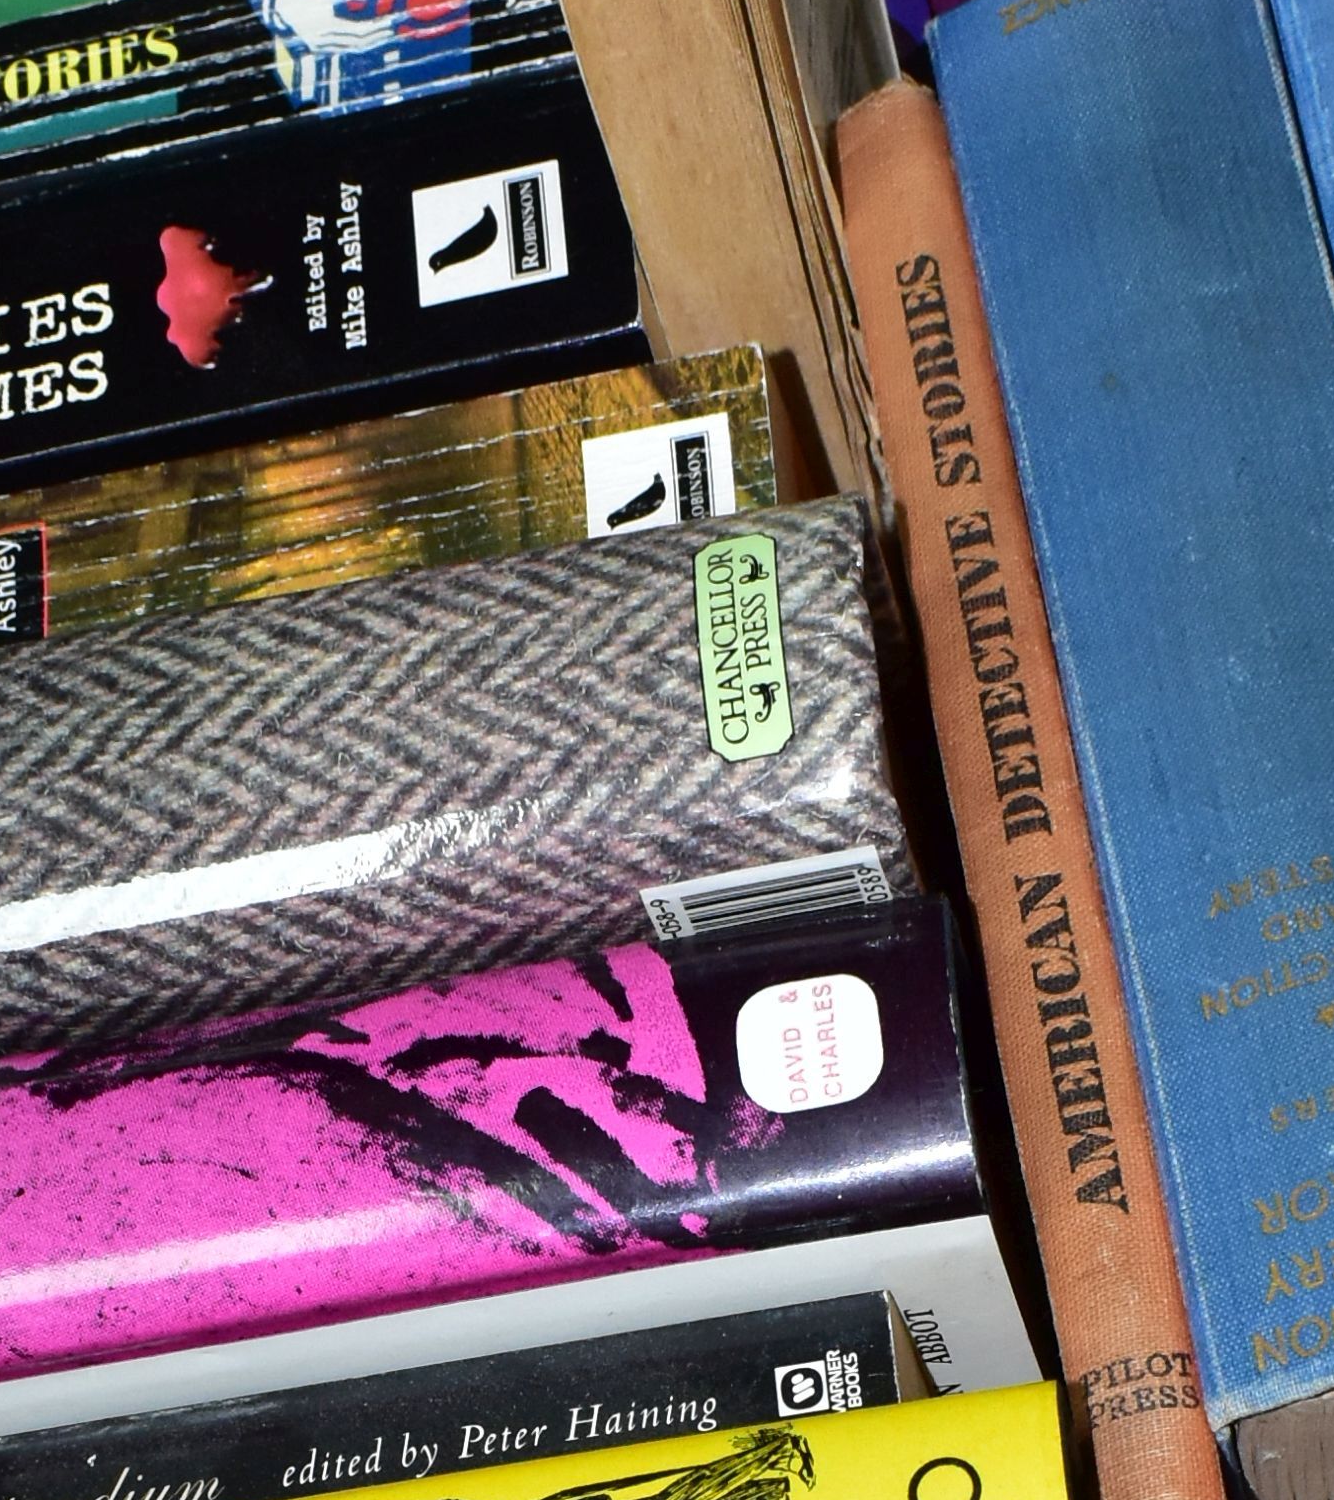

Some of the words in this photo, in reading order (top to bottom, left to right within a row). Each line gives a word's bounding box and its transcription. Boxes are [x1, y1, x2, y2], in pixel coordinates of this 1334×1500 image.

[302, 204, 326, 239] by
[339, 180, 365, 271] Ashley
[516, 179, 543, 271] ROBINSON
[307, 243, 331, 334] Edited
[344, 277, 368, 350] Mike
[894, 249, 983, 489] STORIES
[707, 545, 750, 747] CHANCELLOR
[744, 586, 775, 669] PRESS
[944, 508, 1056, 840] DETECTIVE
[817, 981, 847, 1100] CHARLES
[1009, 873, 1132, 1217] AMERICAN
[844, 1351, 865, 1411] BOOKS
[1078, 1351, 1192, 1398] PILOT
[1088, 1384, 1201, 1429] PRESS
[280, 1437, 385, 1488] edited
[398, 1426, 442, 1479] by
[457, 1412, 548, 1462] Peter
[565, 1394, 719, 1450] Haining
